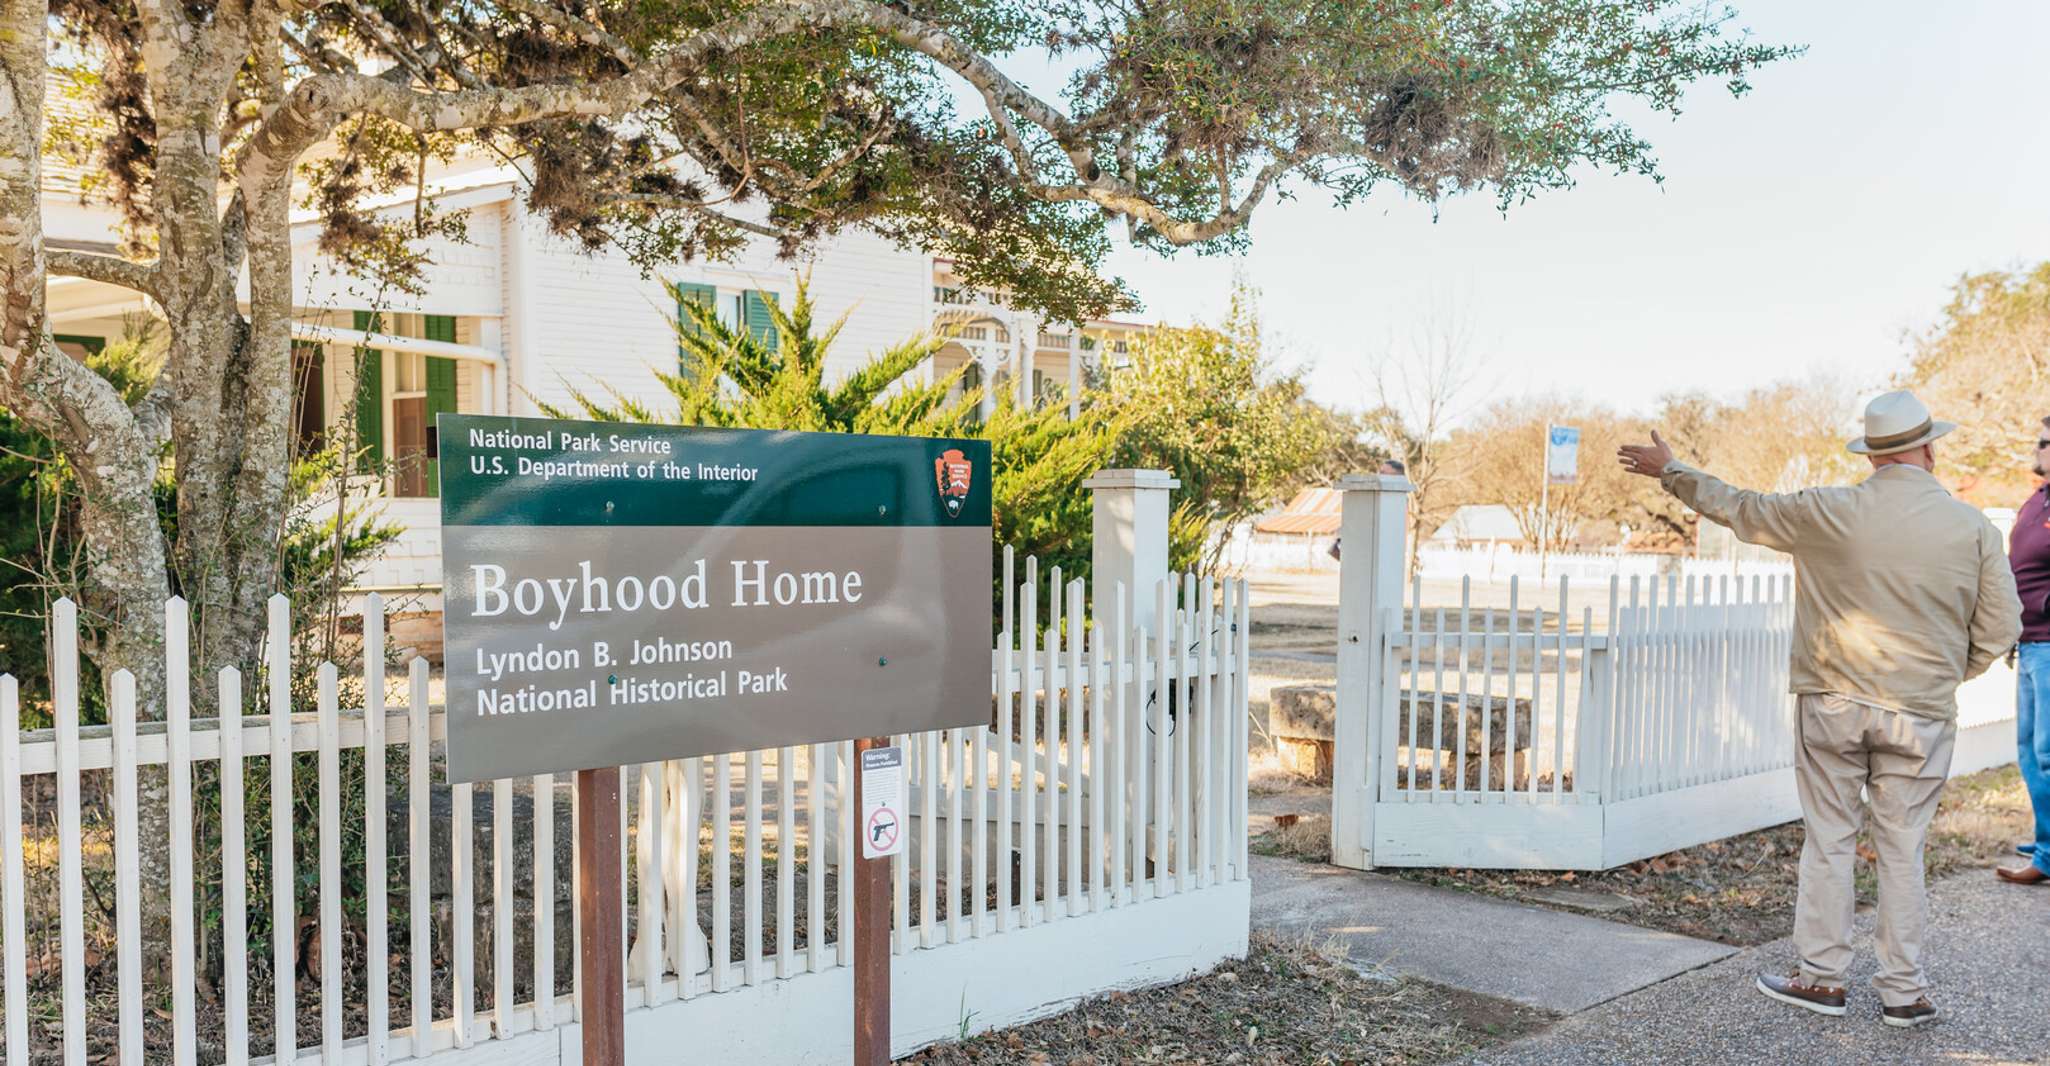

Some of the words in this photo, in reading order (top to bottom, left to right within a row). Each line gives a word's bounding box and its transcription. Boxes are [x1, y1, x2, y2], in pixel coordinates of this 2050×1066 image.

[470, 429, 552, 450] National
[561, 433, 600, 452] Park
[609, 435, 671, 454] Service
[471, 456, 509, 475] U.S.
[518, 458, 629, 482] Department
[637, 462, 655, 479] of
[664, 463, 691, 480] the
[698, 463, 758, 482] Interior
[471, 559, 709, 631] Boyhood
[731, 559, 863, 607] Home
[477, 645, 579, 681] Lyndon
[594, 642, 617, 666] B.
[630, 638, 732, 666] Johnson
[478, 680, 597, 716] National
[611, 672, 726, 705] Historical
[738, 666, 788, 695] Park
